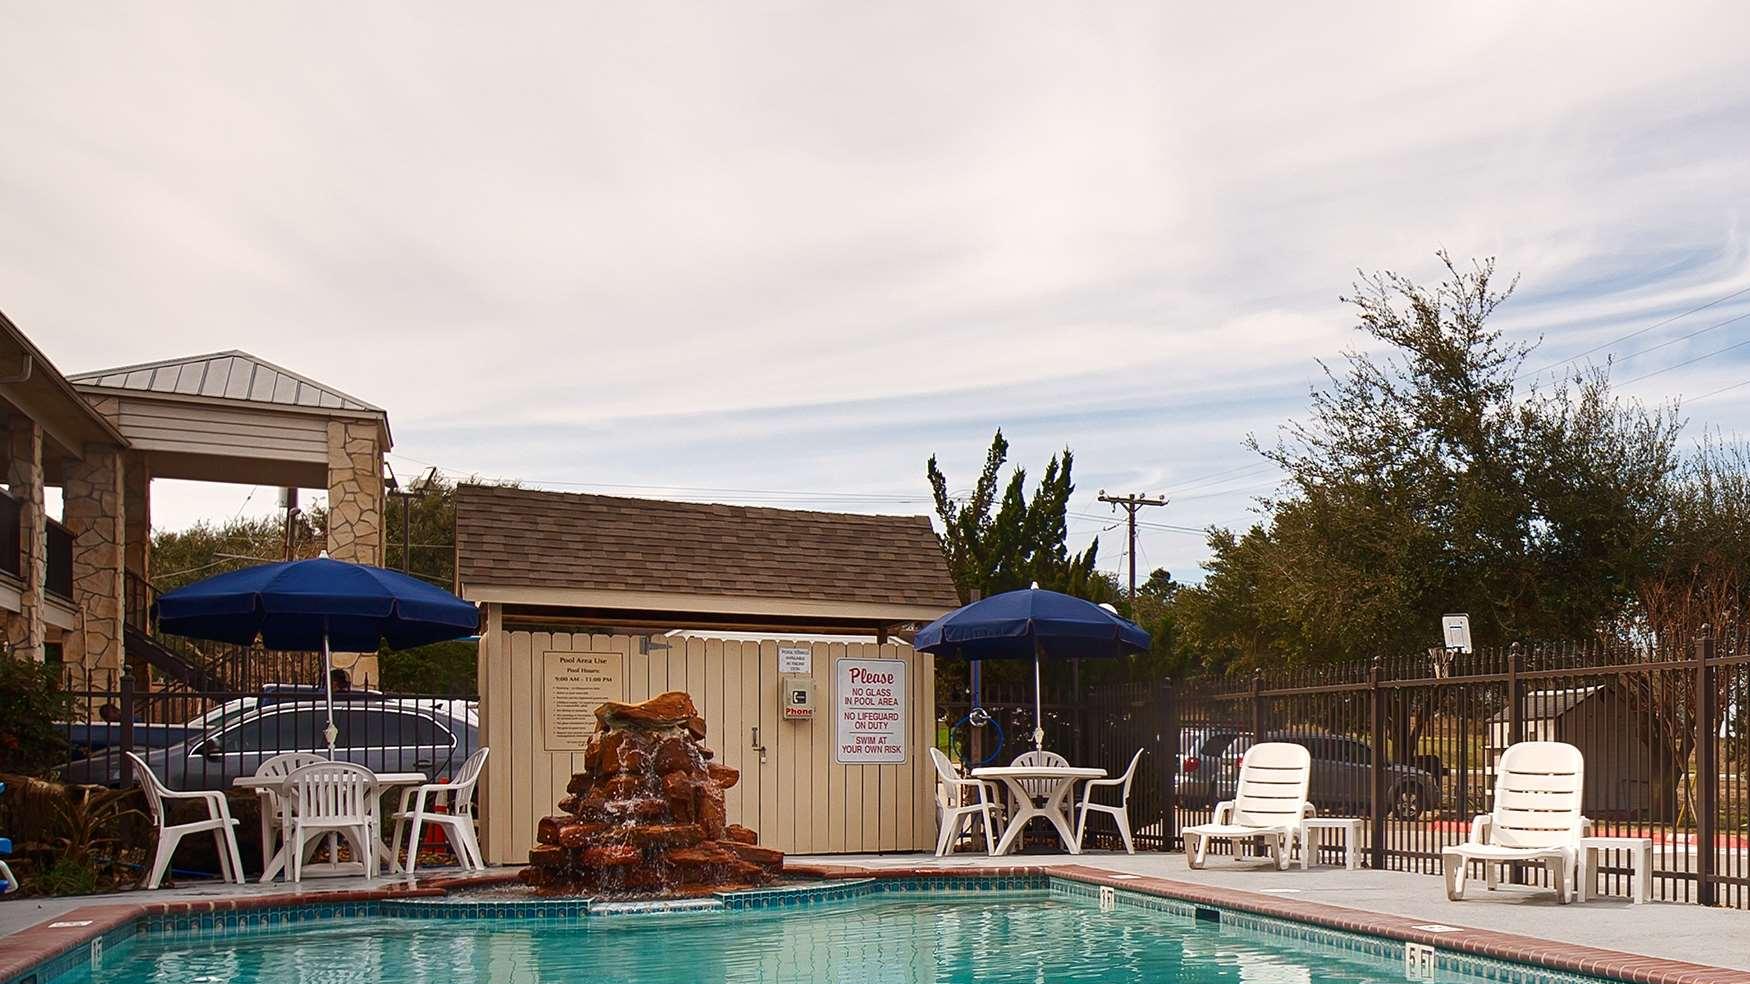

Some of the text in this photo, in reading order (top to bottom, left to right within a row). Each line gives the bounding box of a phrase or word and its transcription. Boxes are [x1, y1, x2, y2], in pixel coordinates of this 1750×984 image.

[849, 668, 895, 684] Please
[852, 688, 891, 697] NO GLASS
[845, 697, 898, 706] IN POOL AREA
[844, 712, 899, 721] NO LIFEGUARD
[868, 722, 888, 730] DUTY
[842, 745, 902, 754] YOUR OWN RISK
[1409, 947, 1416, 968] 5
